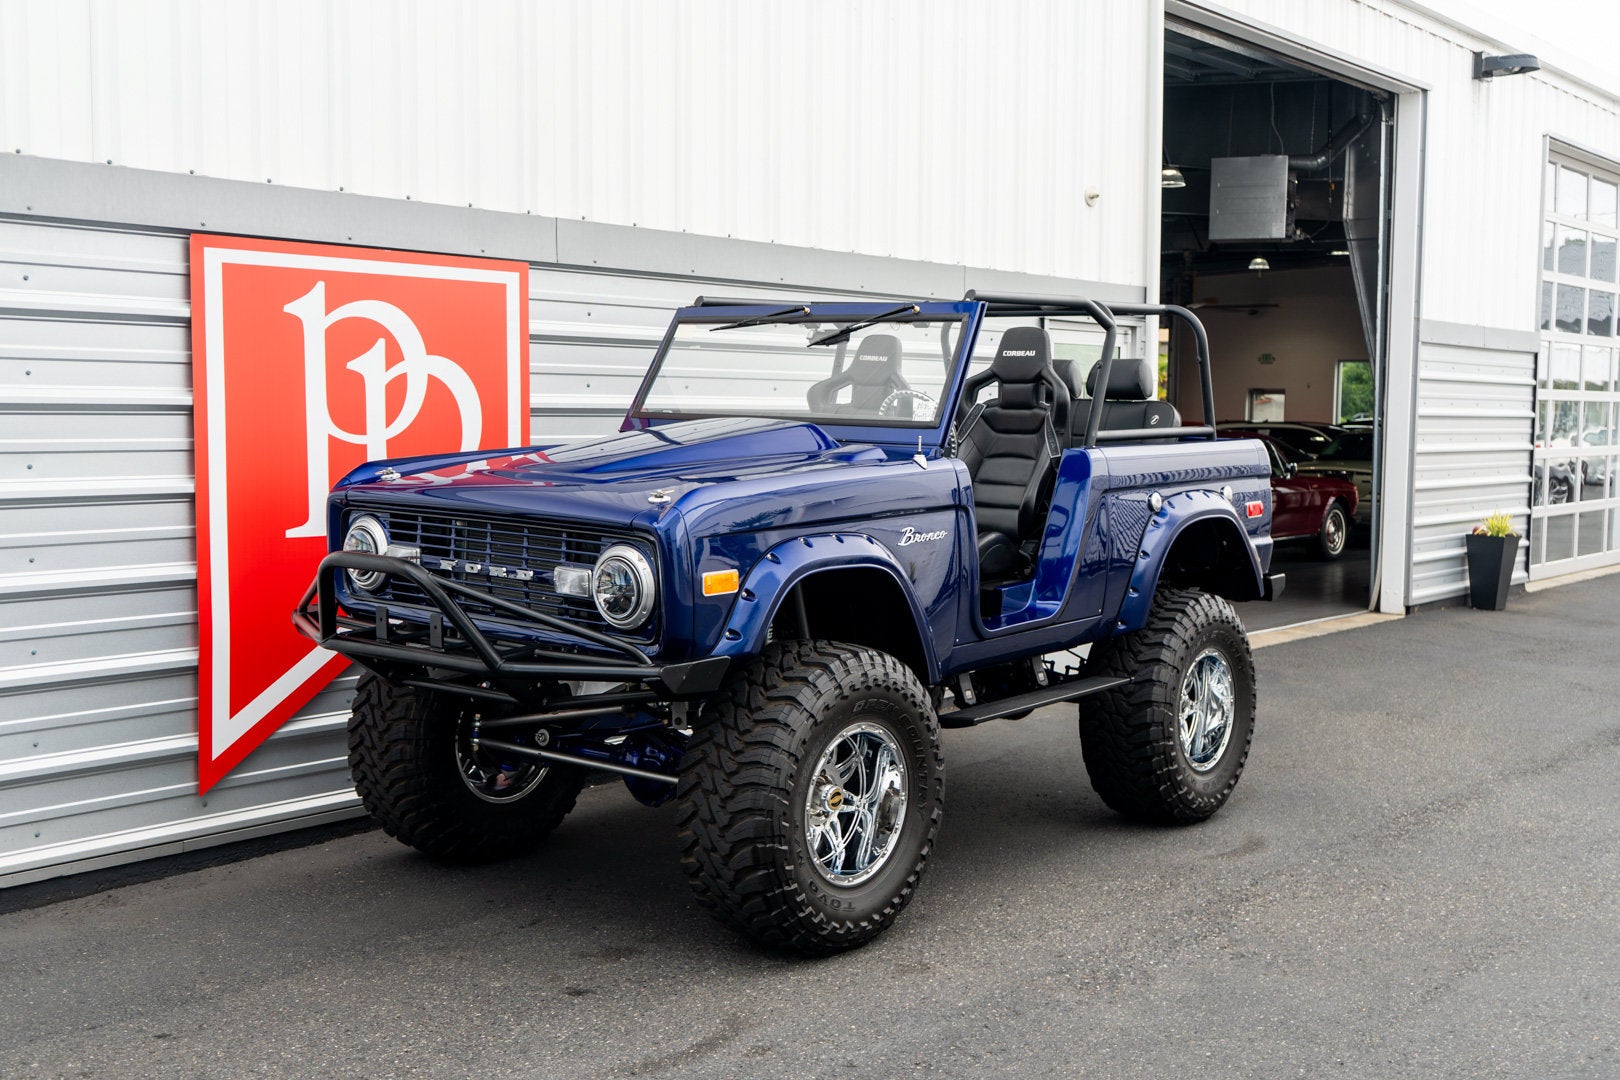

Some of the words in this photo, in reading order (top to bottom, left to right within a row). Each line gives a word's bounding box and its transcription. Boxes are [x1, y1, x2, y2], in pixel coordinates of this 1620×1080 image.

[897, 526, 948, 546] Bronco
[440, 559, 534, 581] FORD
[808, 878, 858, 913] TOYO
